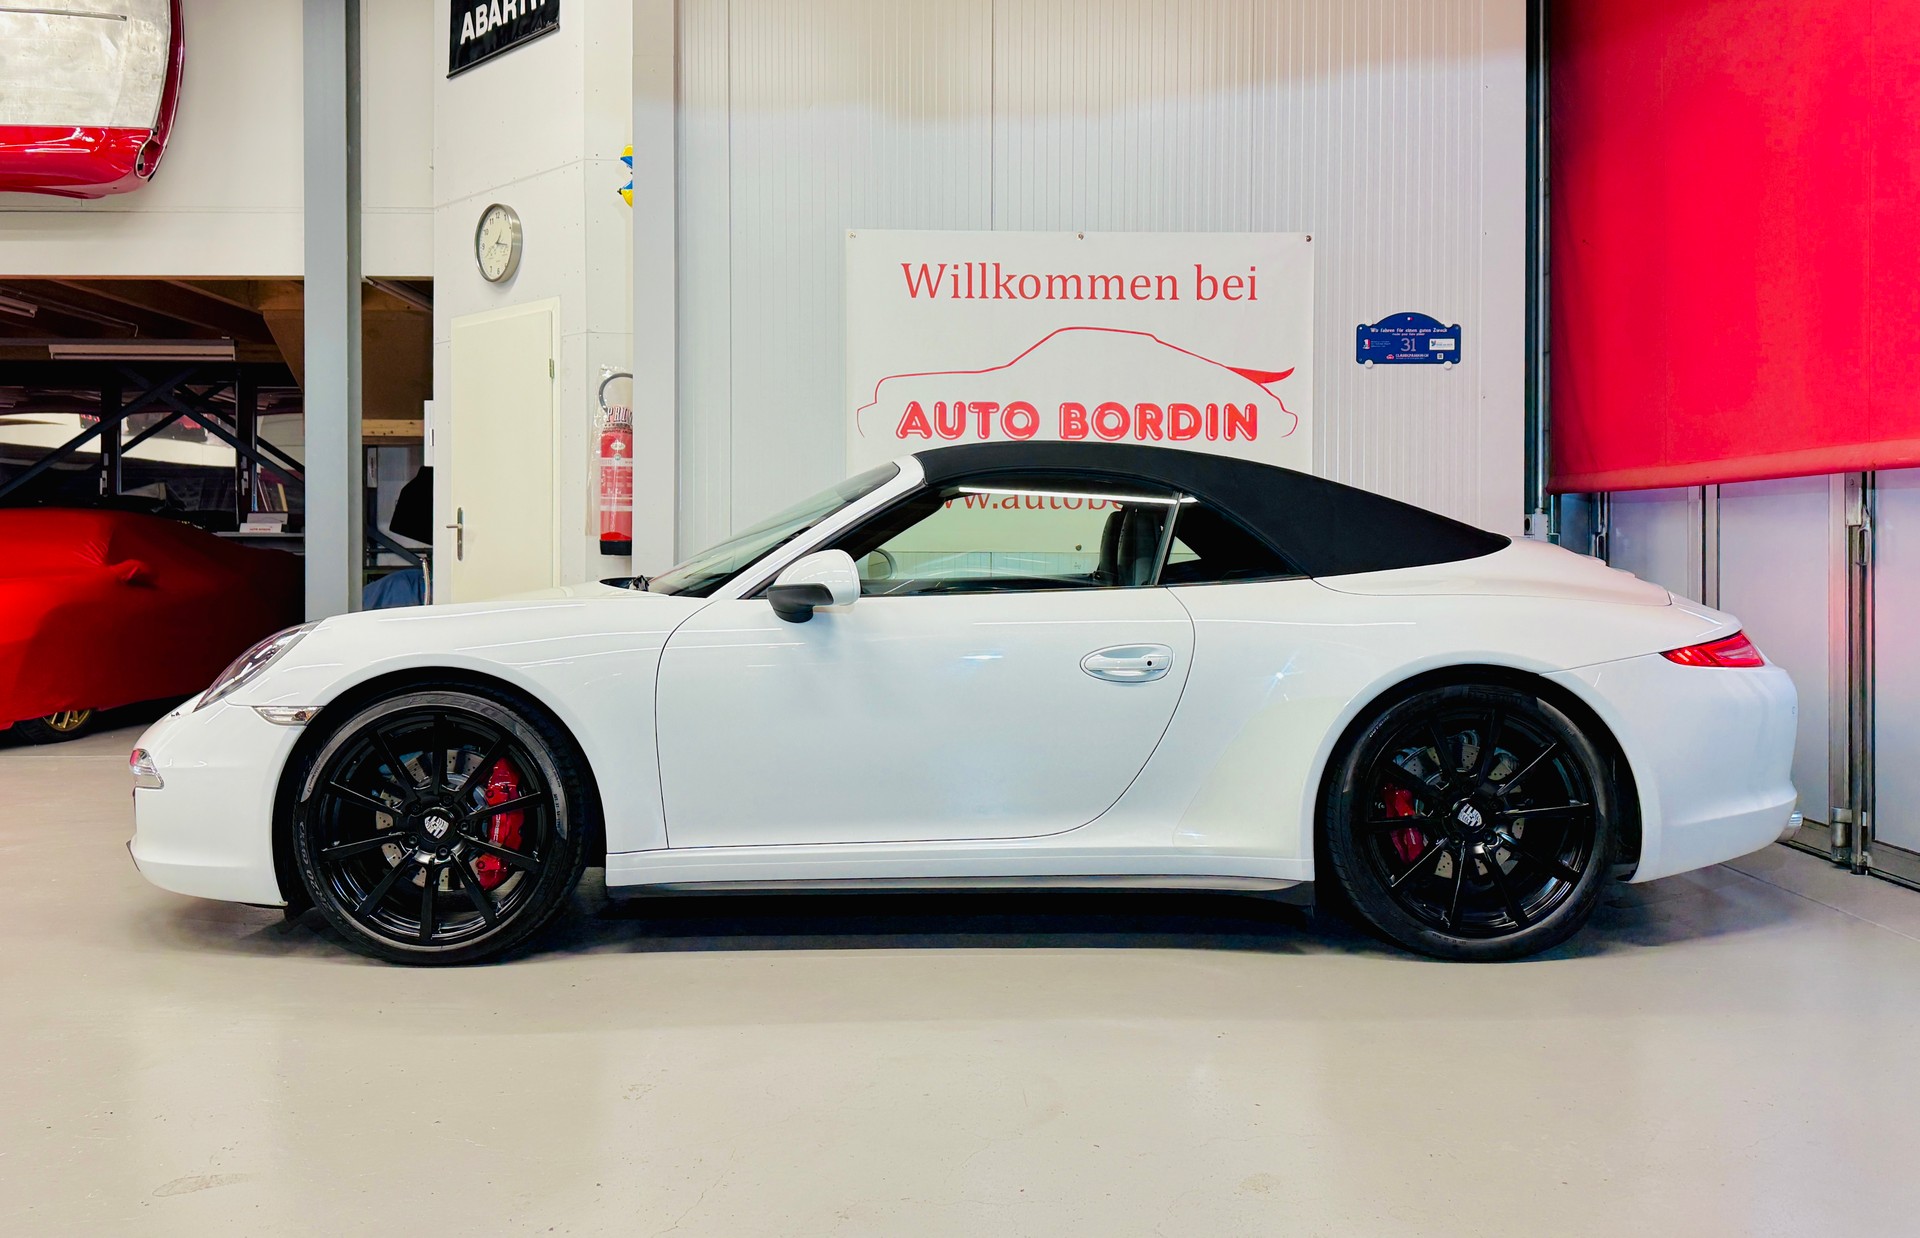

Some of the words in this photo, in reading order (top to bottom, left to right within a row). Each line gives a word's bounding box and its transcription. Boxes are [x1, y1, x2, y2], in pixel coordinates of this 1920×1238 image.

[460, 0, 546, 45] ABAR
[901, 262, 1180, 301] Willkommen
[1194, 264, 1258, 301] bei
[1400, 337, 1417, 352] 31
[896, 401, 1041, 441] AUTO
[1058, 402, 1259, 442] BORDIN
